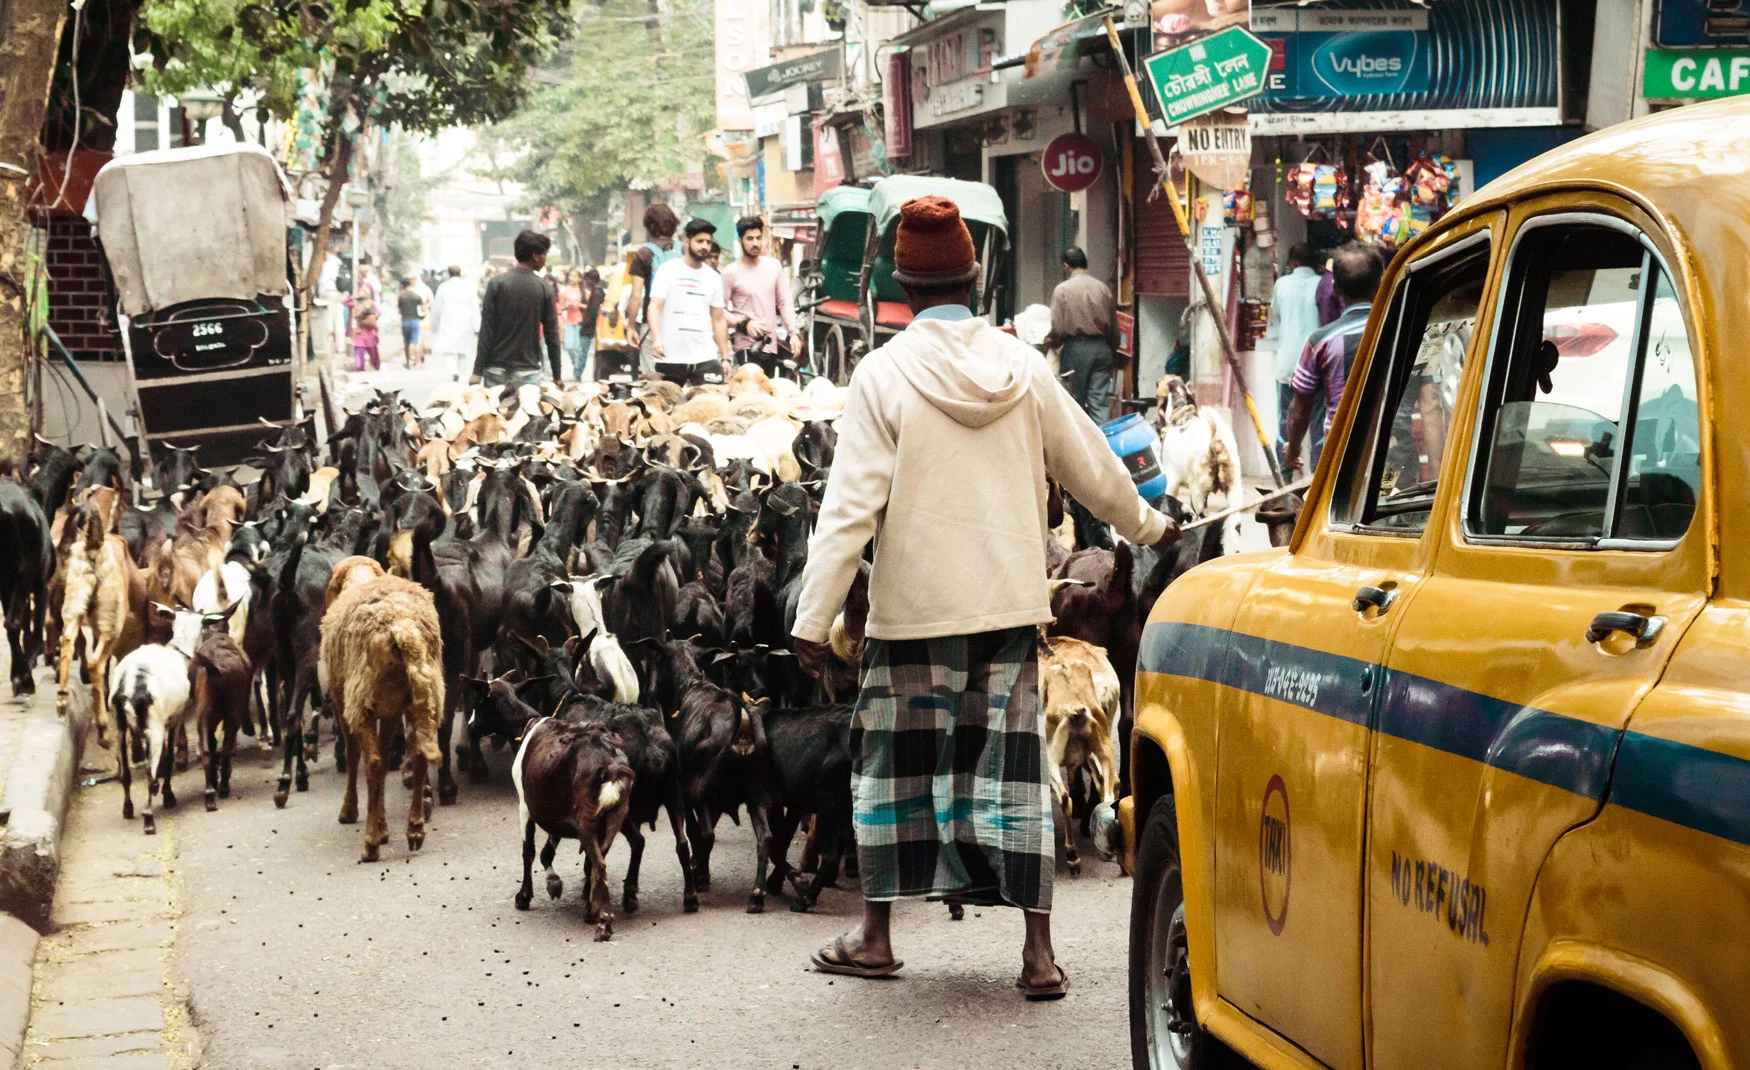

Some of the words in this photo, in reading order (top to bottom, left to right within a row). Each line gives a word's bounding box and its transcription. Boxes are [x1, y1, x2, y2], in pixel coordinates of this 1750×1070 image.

[781, 60, 822, 79] JOCKEY
[1330, 52, 1401, 78] Vybes
[1167, 82, 1230, 118] CHOWRINGHEE
[1232, 71, 1258, 92] LANE
[1188, 128, 1210, 151] NO
[1214, 127, 1246, 150] ENTRY
[1051, 150, 1095, 176] Jio
[193, 322, 223, 337] 2566
[1264, 815, 1286, 877] TAXI
[1391, 850, 1412, 908] NO
[1414, 859, 1490, 949] REFUSAL
